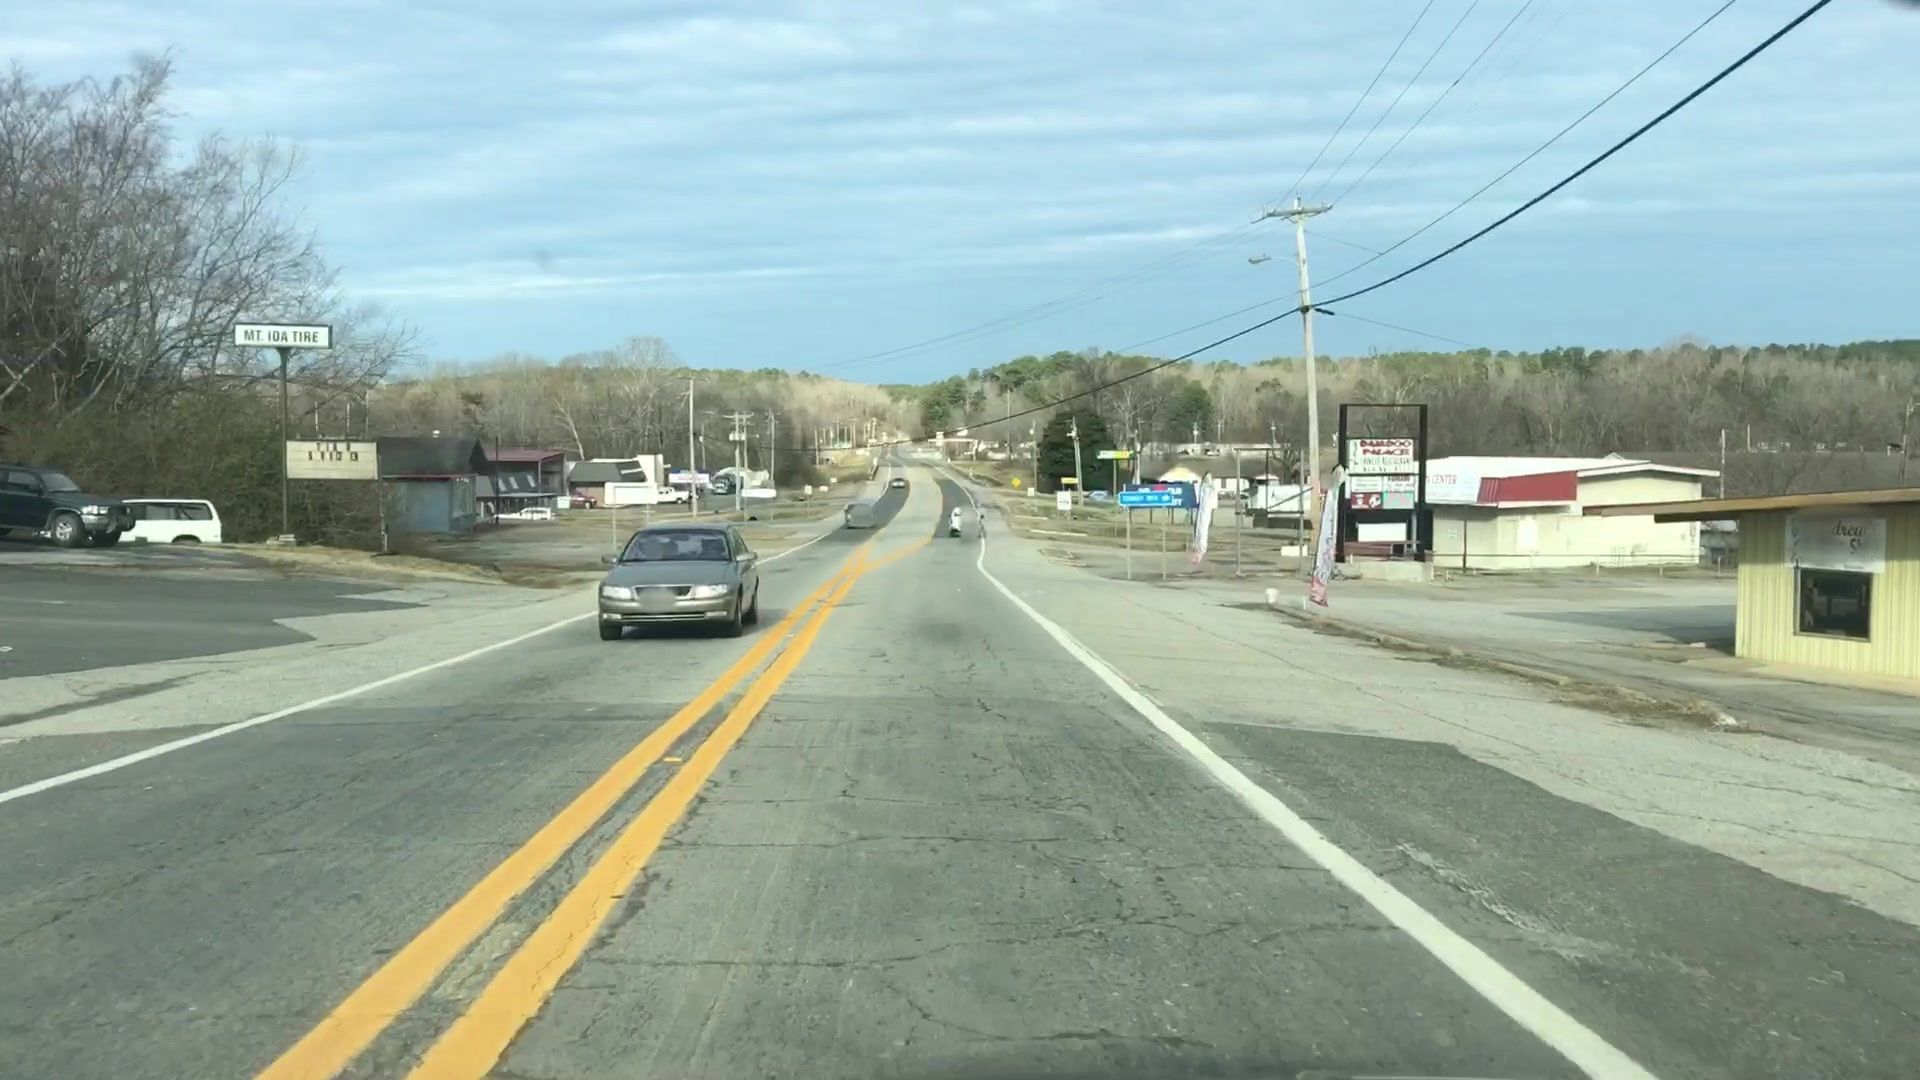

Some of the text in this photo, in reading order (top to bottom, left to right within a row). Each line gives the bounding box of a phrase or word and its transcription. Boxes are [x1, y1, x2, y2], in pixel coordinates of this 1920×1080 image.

[243, 329, 264, 341] MT.
[292, 331, 319, 343] TIRE
[1431, 474, 1457, 485] CENTER
